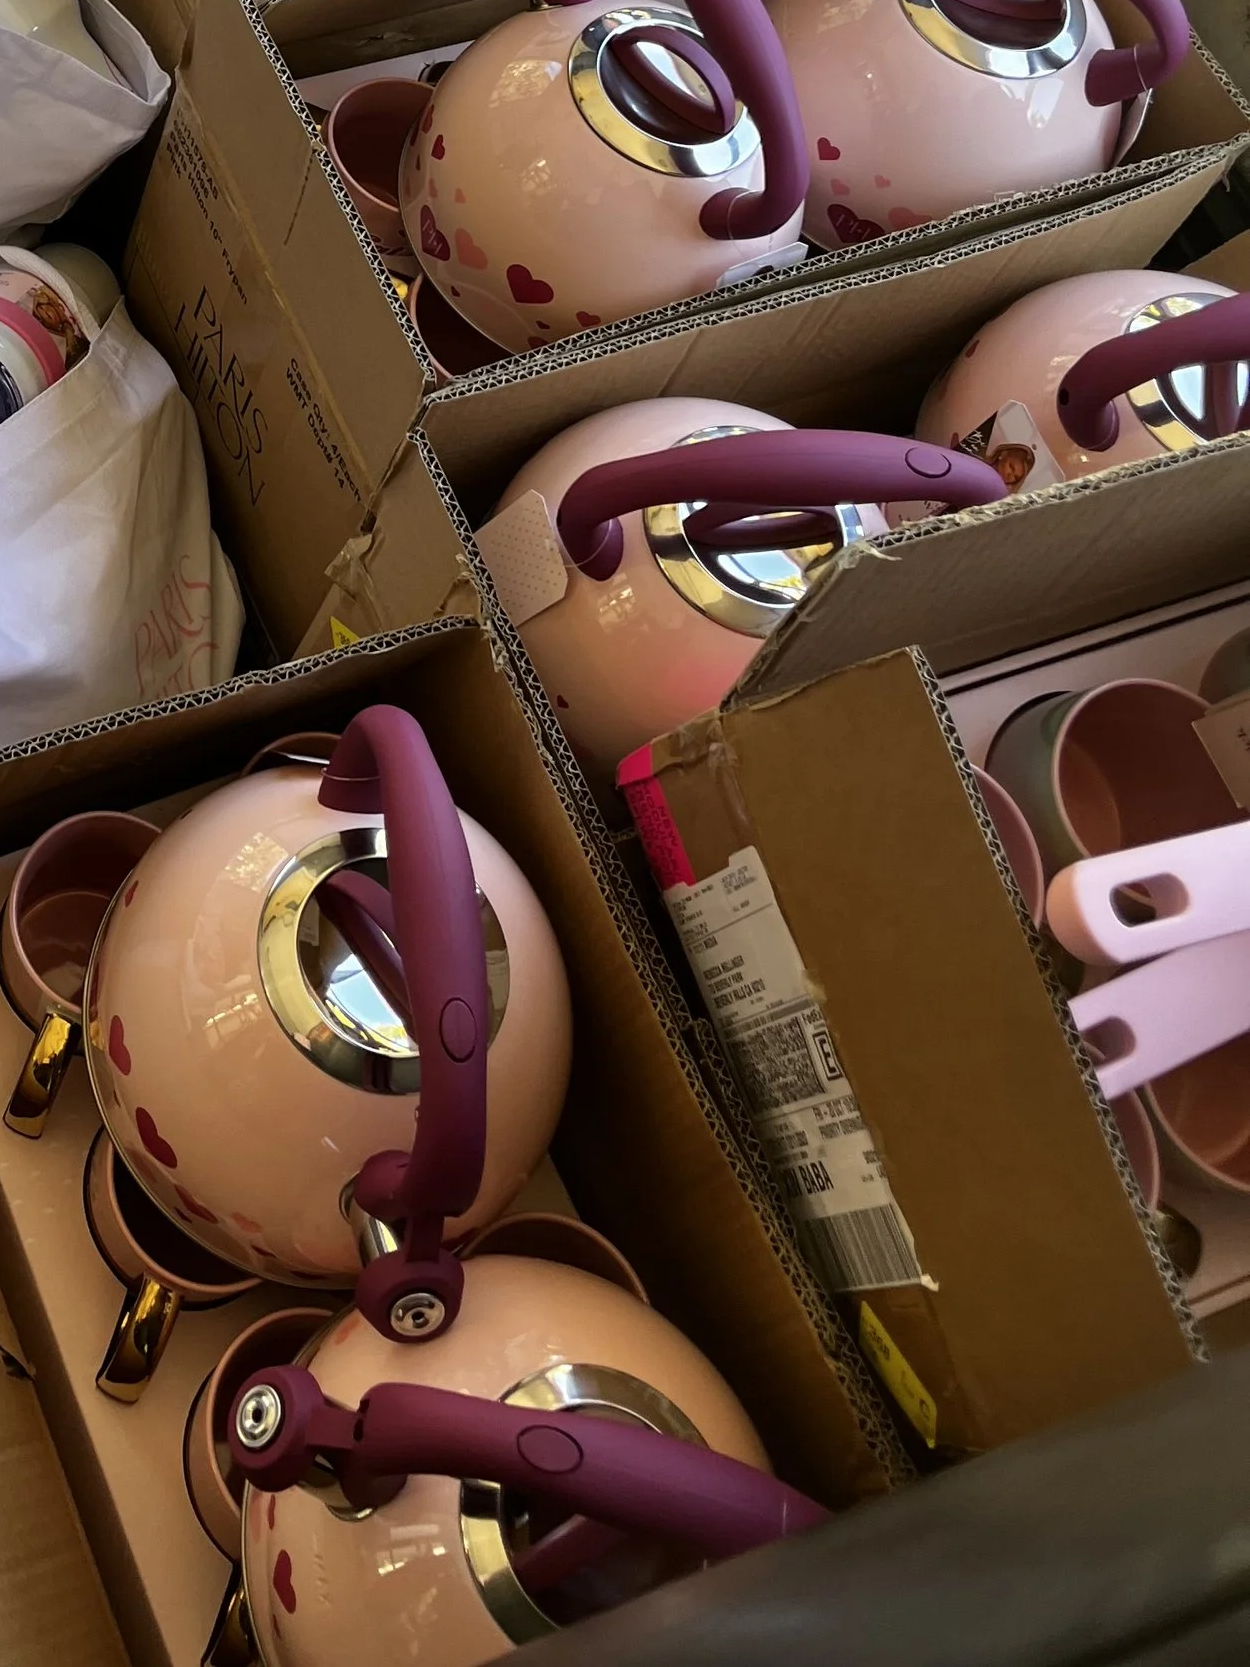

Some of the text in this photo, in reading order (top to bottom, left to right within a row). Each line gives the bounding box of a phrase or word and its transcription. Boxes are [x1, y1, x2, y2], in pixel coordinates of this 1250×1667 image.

[188, 174, 209, 220] Hilton
[222, 247, 249, 306] Frypan
[174, 301, 266, 507] HILTON
[193, 285, 269, 455] PARIS
[285, 366, 308, 411] WMT
[332, 467, 347, 490] 14
[290, 357, 314, 403] Case
[134, 554, 213, 698] PARIS
